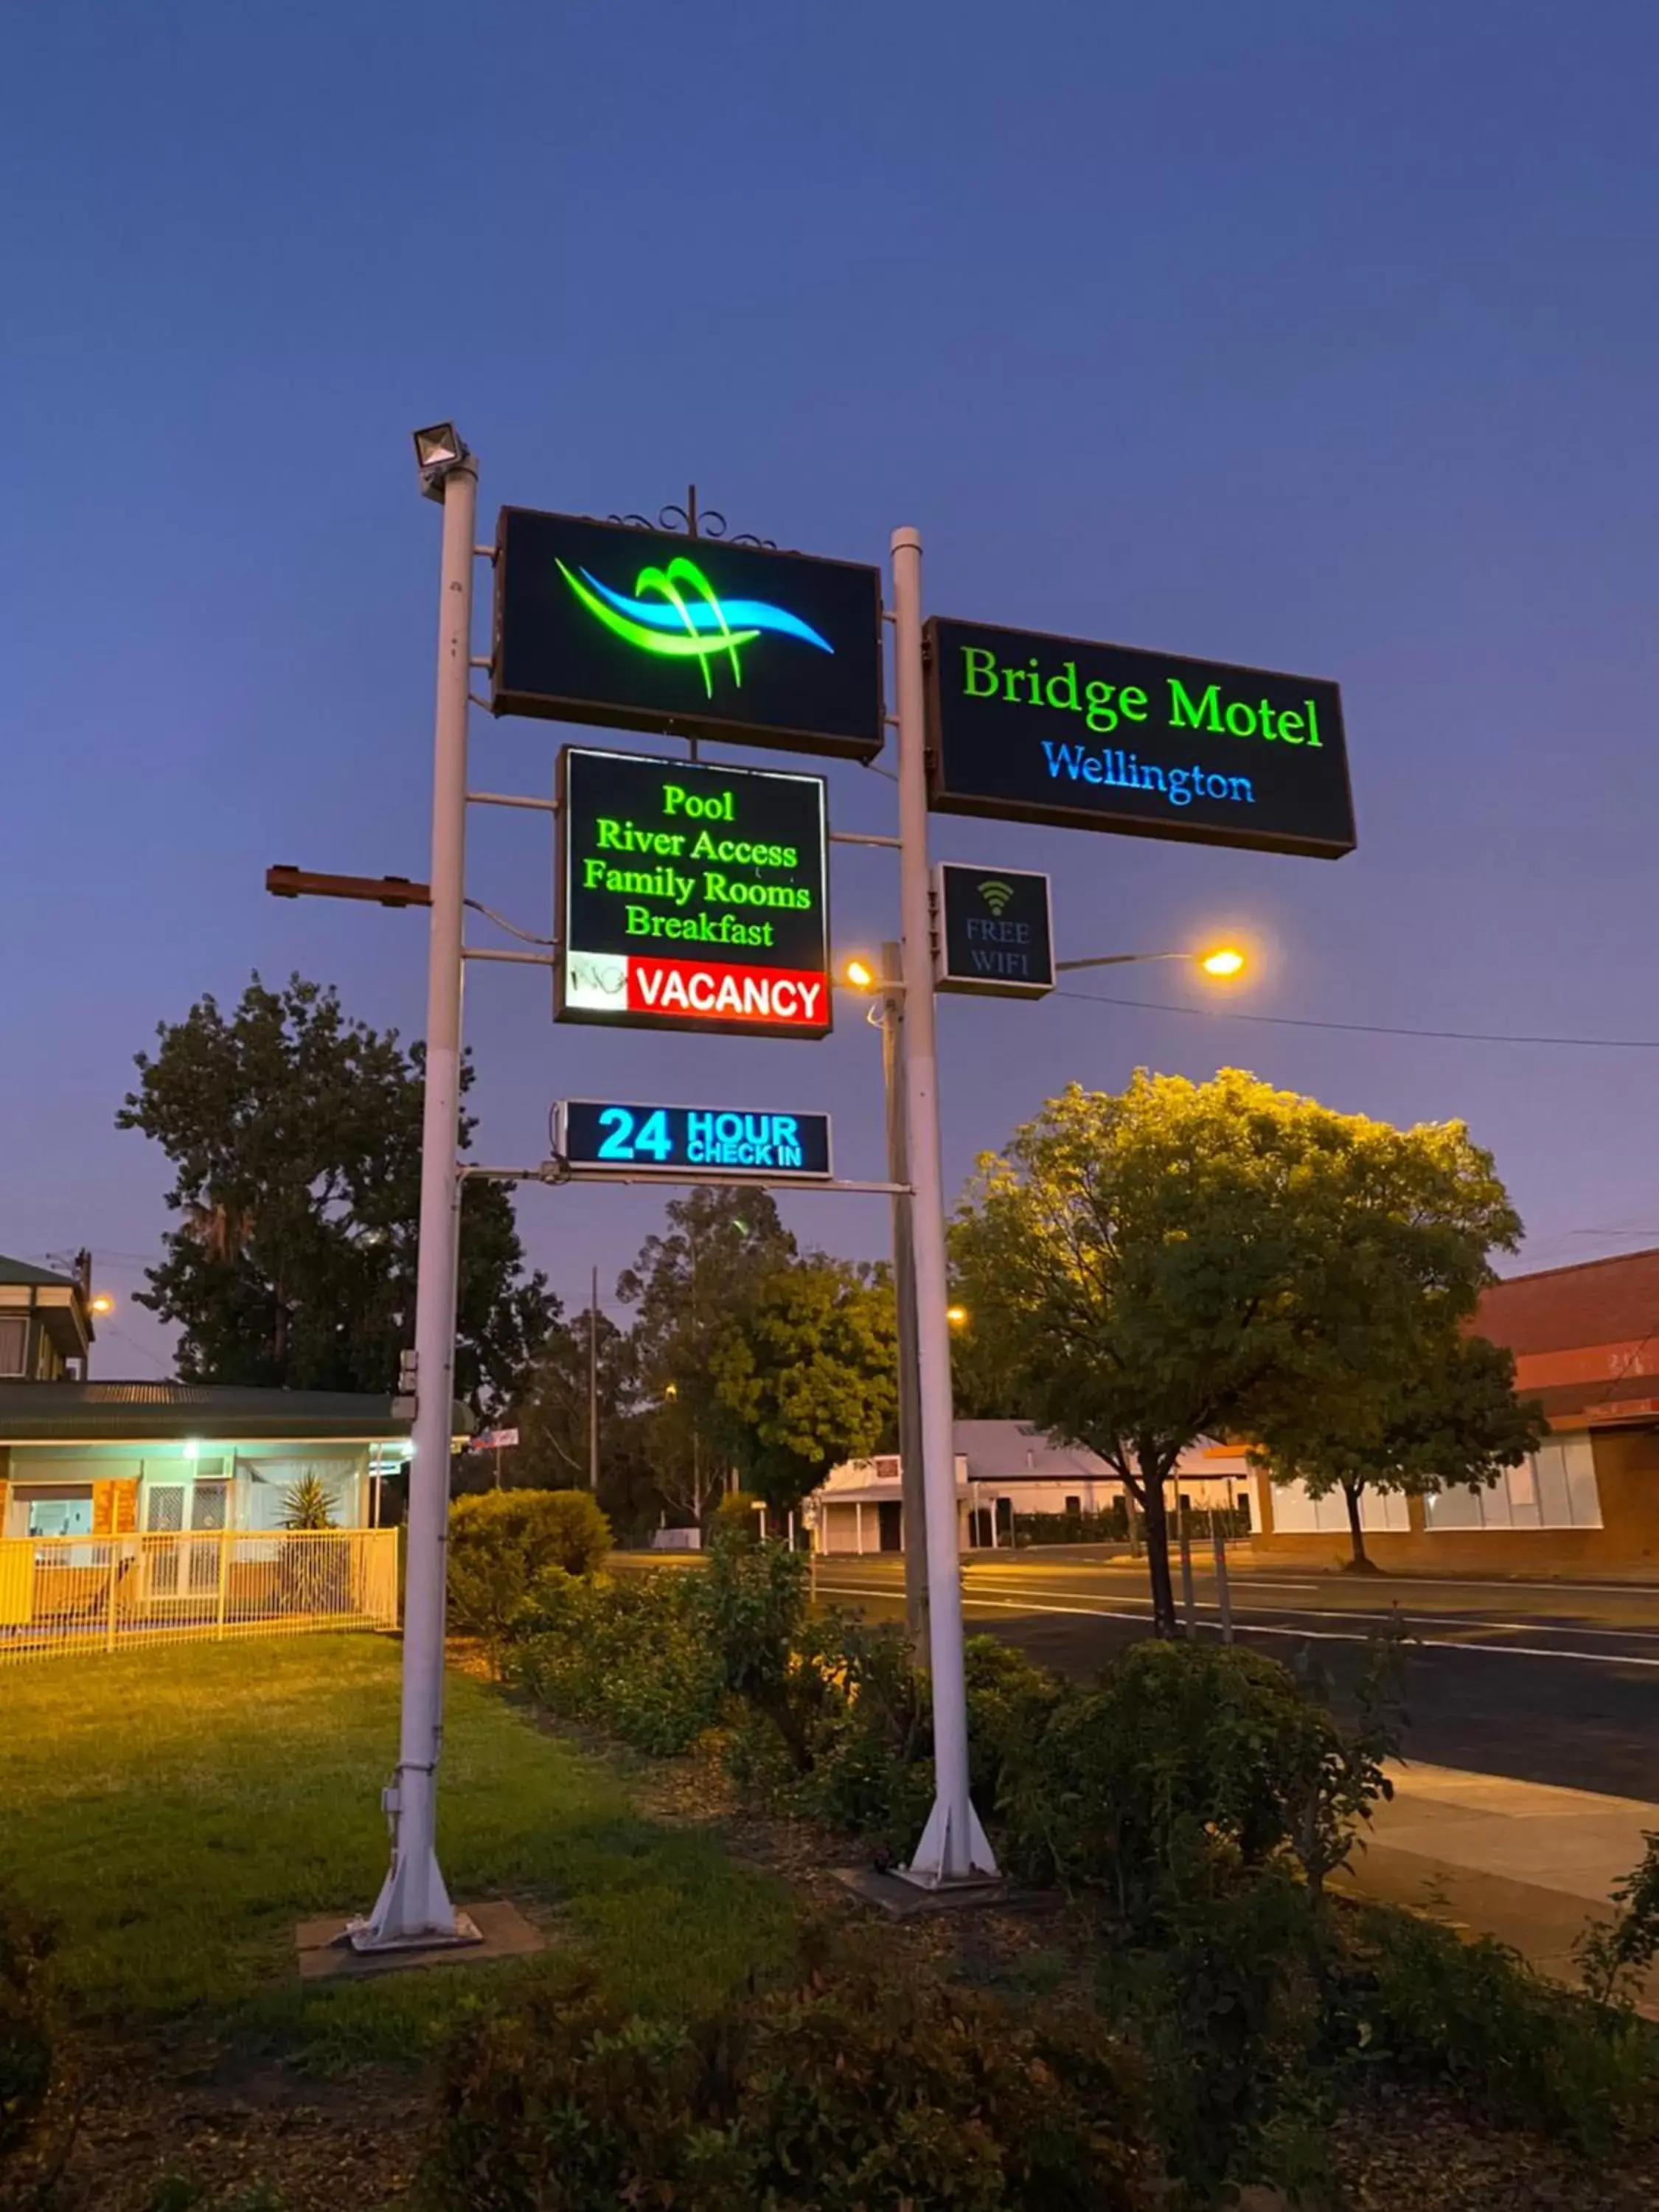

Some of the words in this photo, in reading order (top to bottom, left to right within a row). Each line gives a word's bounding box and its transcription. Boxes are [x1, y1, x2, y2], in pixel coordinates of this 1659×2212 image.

[961, 645, 1148, 732] Bridge
[1166, 678, 1323, 747] Motel
[1040, 740, 1255, 806] Wellington
[662, 785, 735, 821] Pool
[596, 818, 685, 856] River
[689, 831, 798, 868] Access
[582, 858, 695, 906] Family
[703, 871, 812, 910] Rooms
[625, 904, 774, 947] Breakfast
[967, 918, 1030, 944] FREE
[971, 949, 1029, 975] WIFI
[636, 966, 821, 1019] VACANCY
[597, 1107, 672, 1161] 24
[686, 1111, 799, 1147] HOUR
[686, 1141, 773, 1165] CHECK
[777, 1144, 802, 1166] IN
